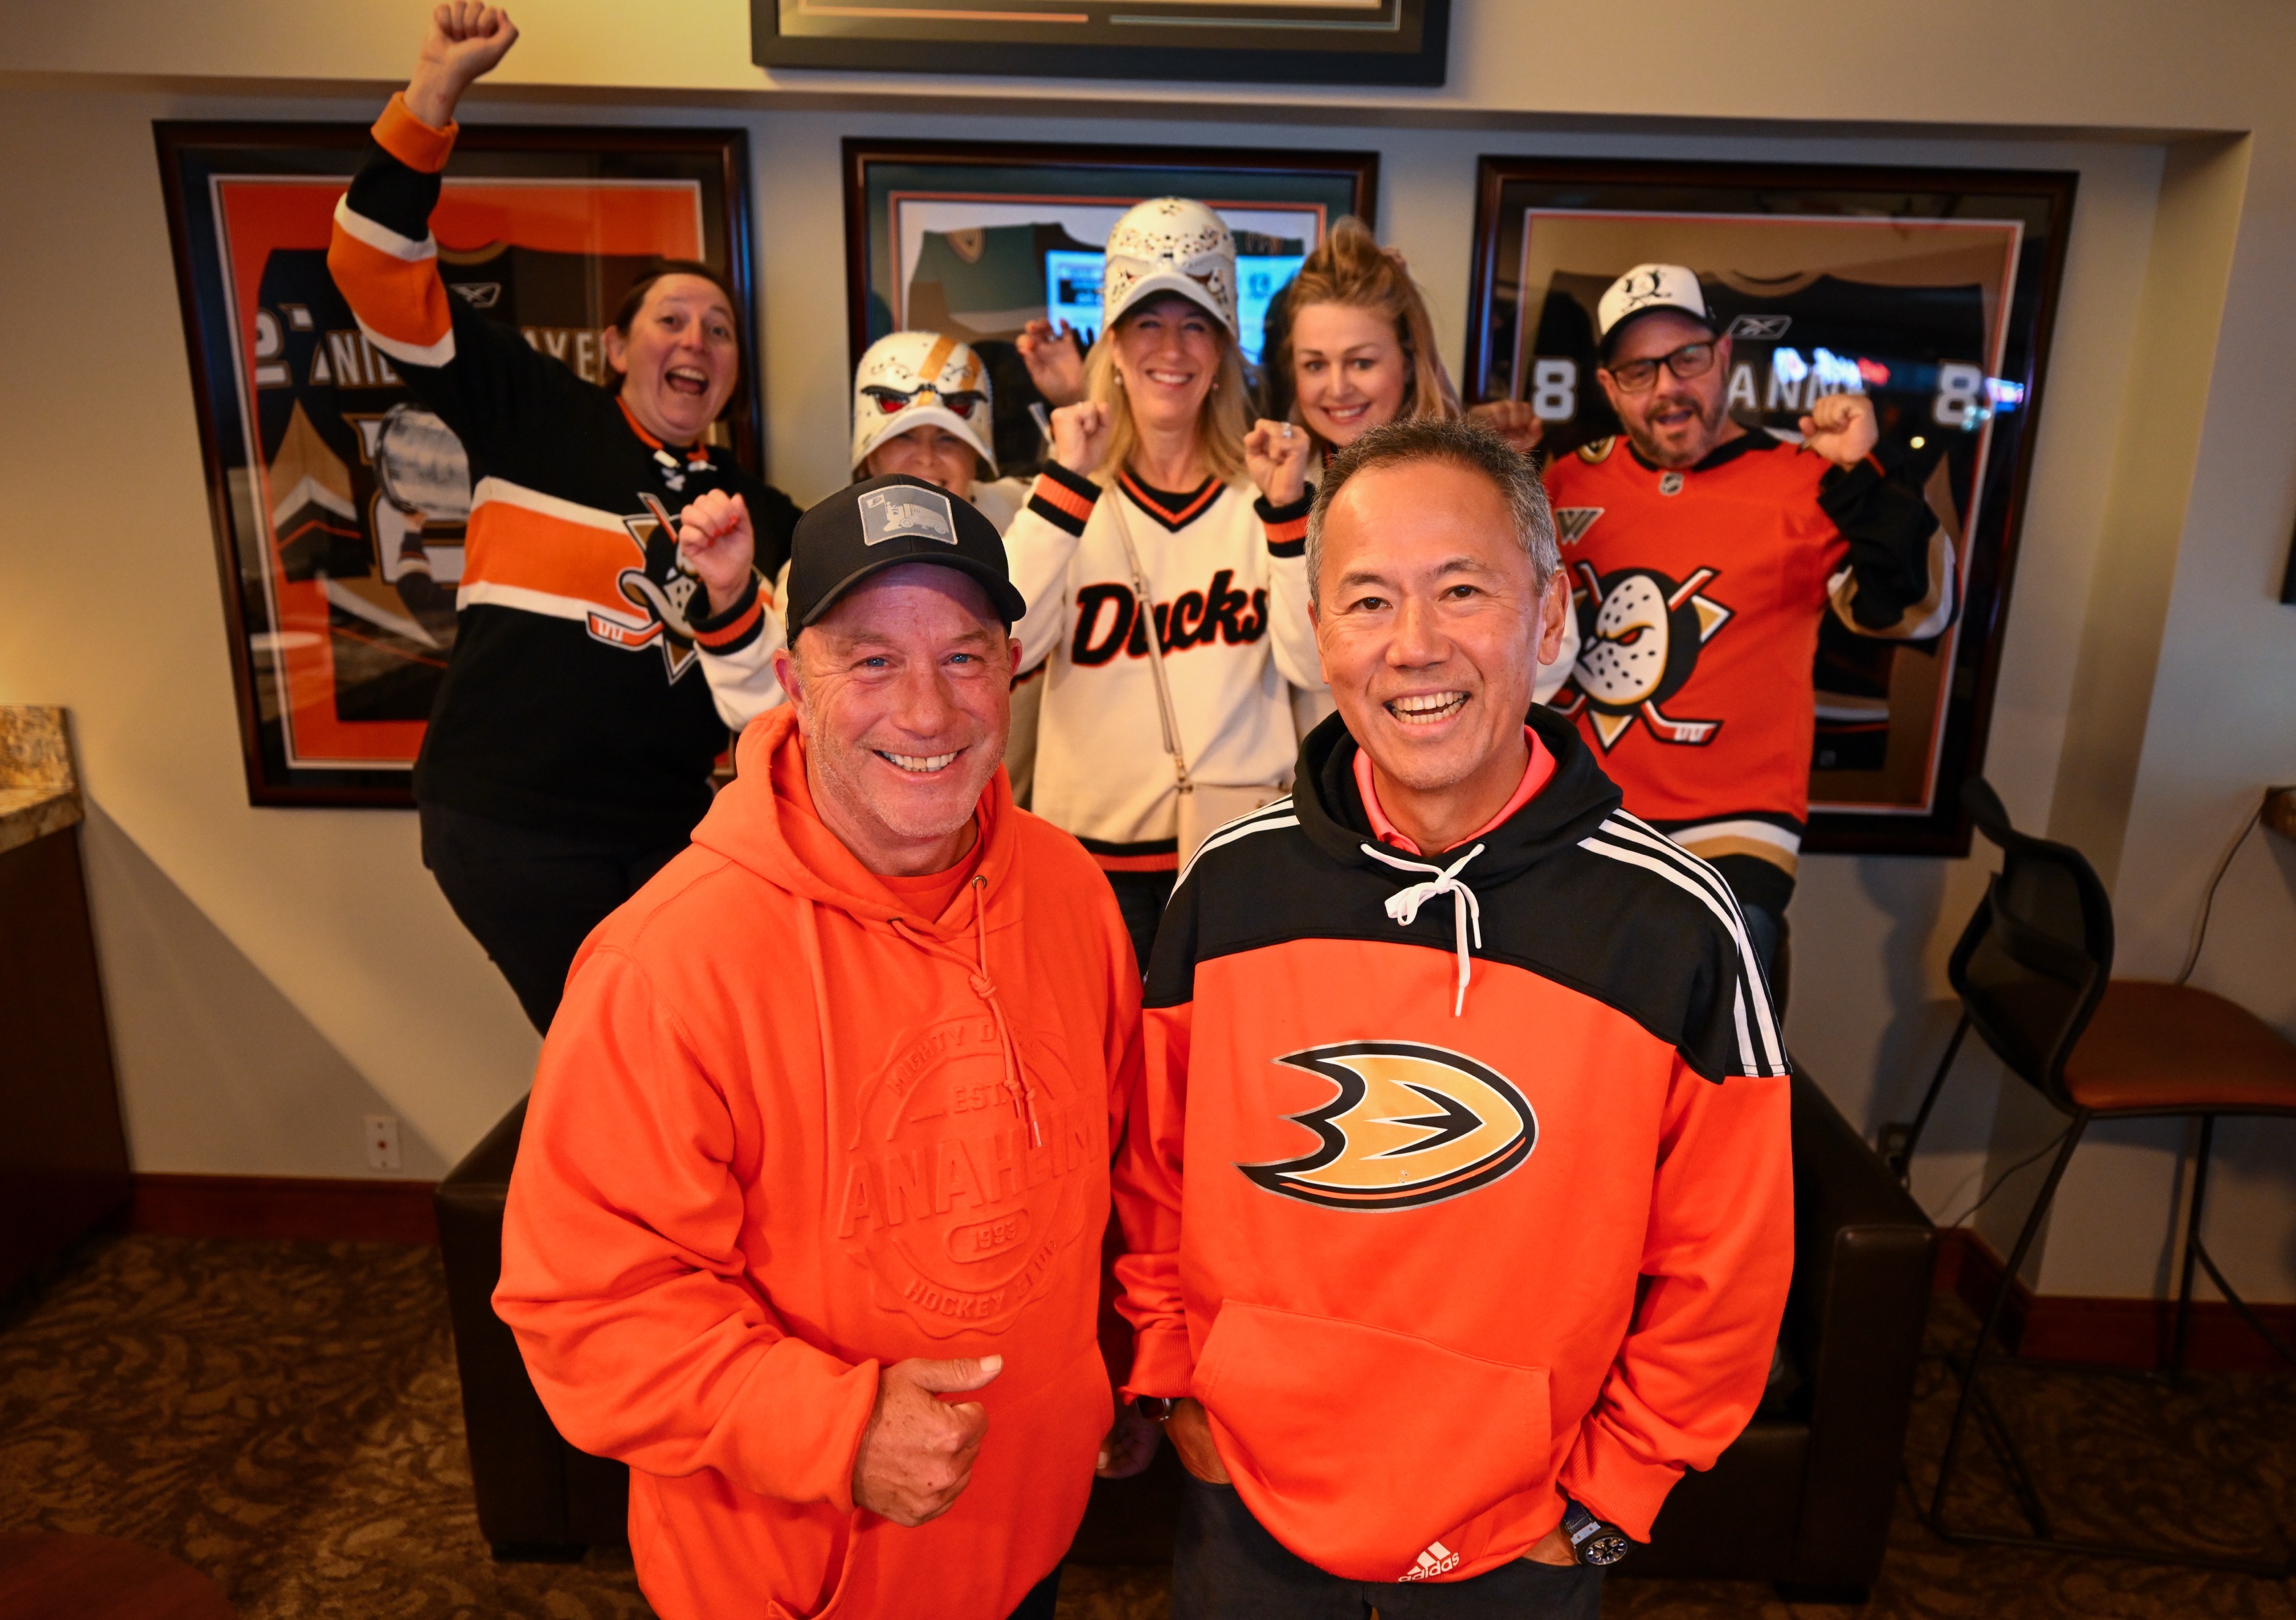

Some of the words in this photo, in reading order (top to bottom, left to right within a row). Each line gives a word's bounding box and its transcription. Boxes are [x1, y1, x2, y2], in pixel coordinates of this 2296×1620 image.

[1532, 358, 1577, 423] 8
[1933, 360, 1984, 426] 8
[1071, 568, 1269, 668] Ducks
[886, 1025, 965, 1094] MIGHTY
[836, 1101, 1101, 1239] ANAHEIM
[974, 1222, 1017, 1253] 1993
[904, 1279, 1006, 1318] HOCKEY
[1398, 1552, 1460, 1583] adidas
